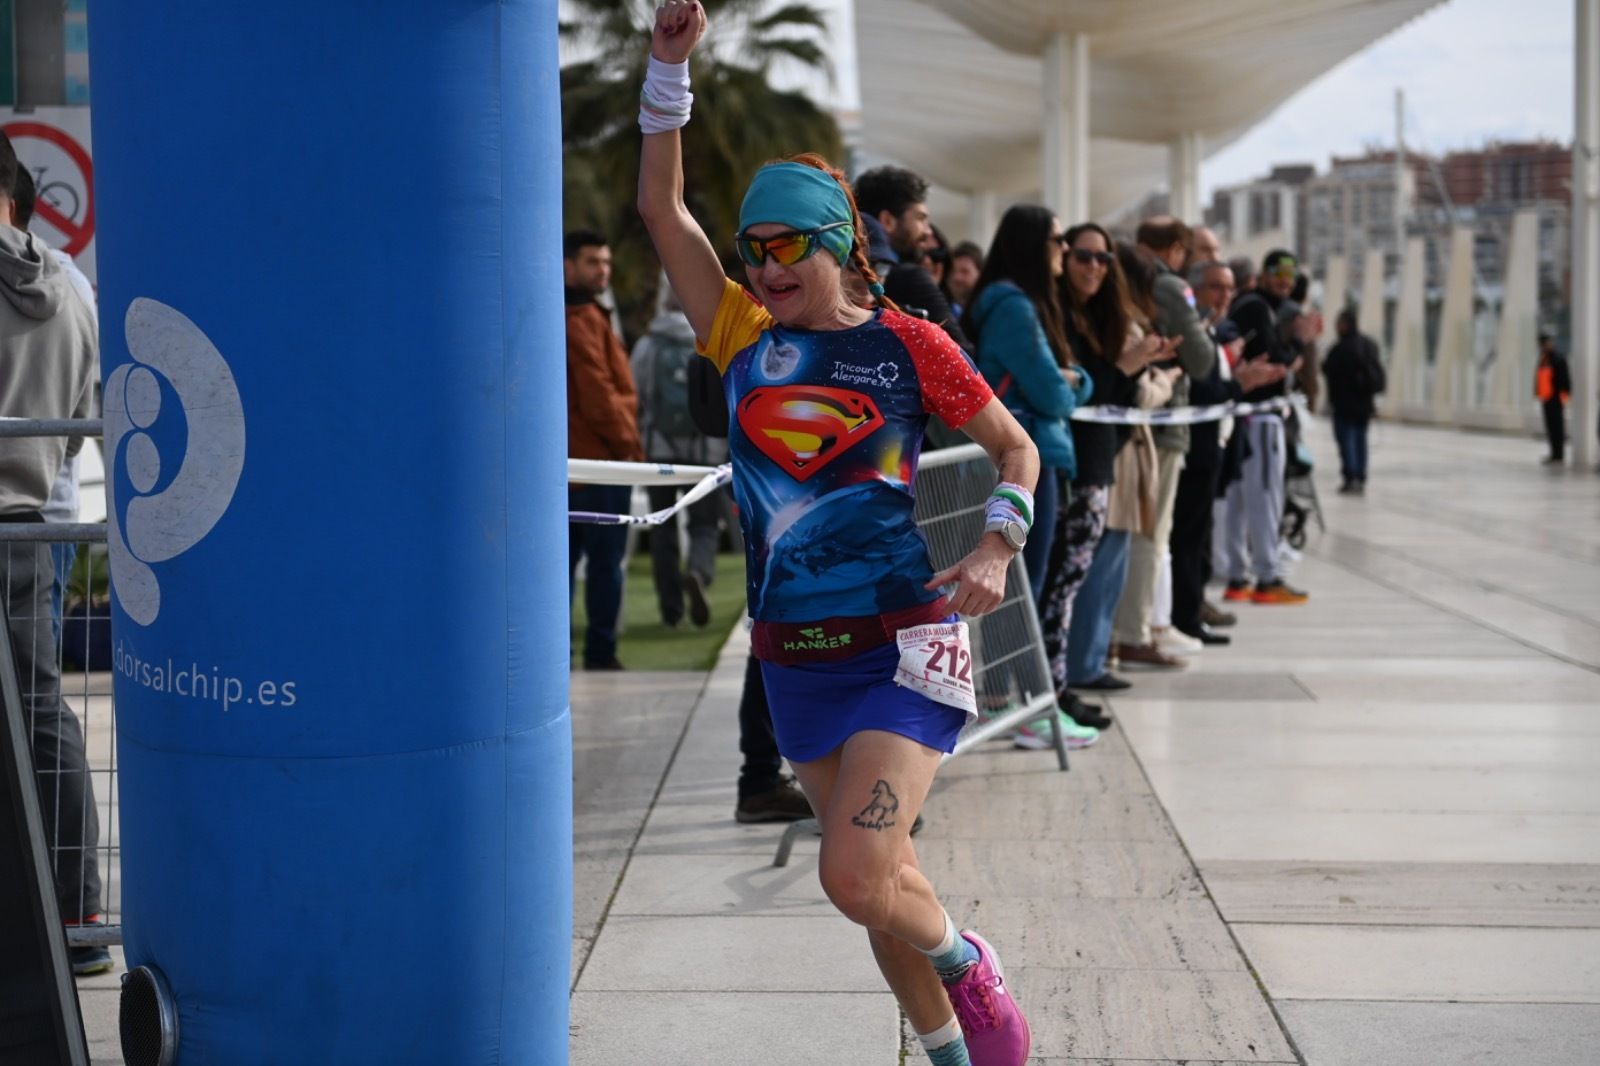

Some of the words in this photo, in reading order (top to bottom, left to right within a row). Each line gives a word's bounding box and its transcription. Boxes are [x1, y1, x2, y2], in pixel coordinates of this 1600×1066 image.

[833, 361, 877, 375] Tricouri
[783, 633, 852, 651] HANKER
[900, 628, 933, 641] CARRERA
[926, 641, 971, 685] 212
